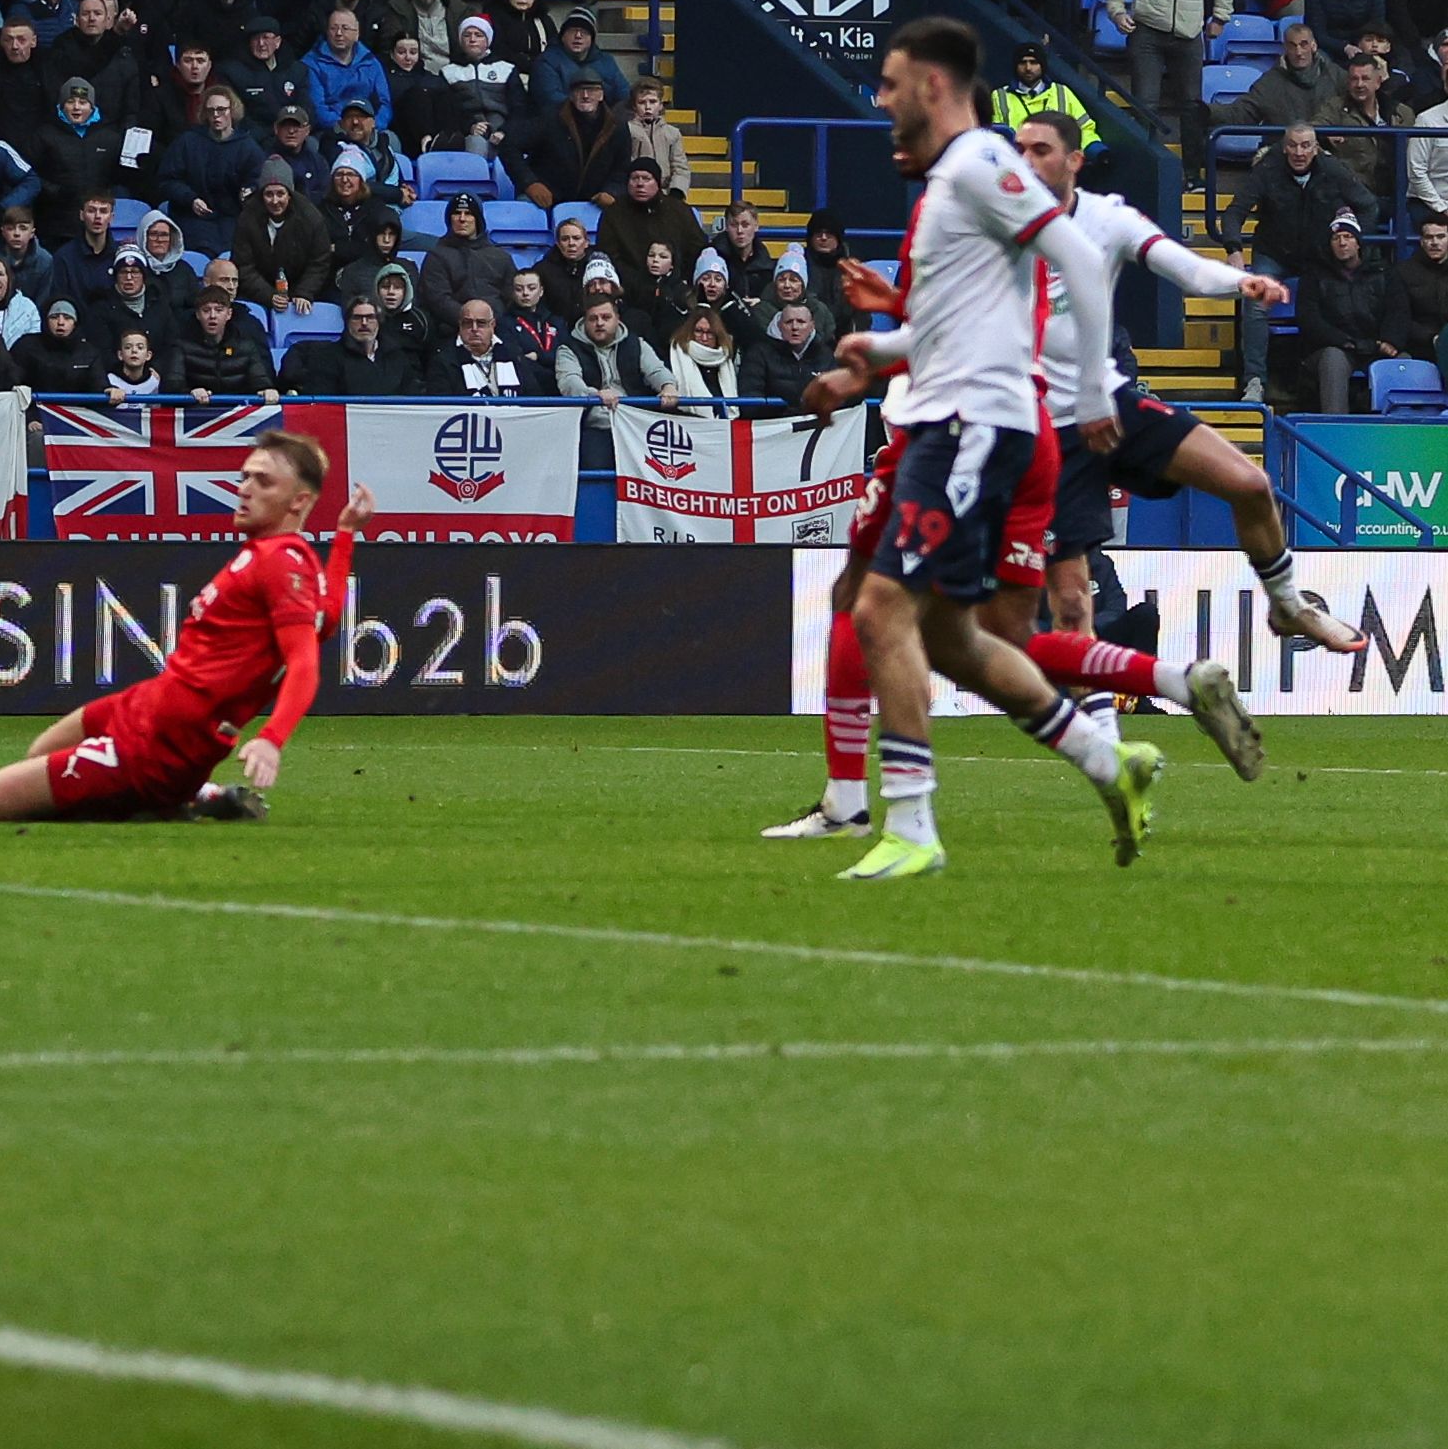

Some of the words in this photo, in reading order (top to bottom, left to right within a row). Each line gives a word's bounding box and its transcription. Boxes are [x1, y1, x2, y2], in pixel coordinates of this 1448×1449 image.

[839, 25, 874, 48] Kia
[792, 419, 827, 482] 7
[627, 479, 761, 516] BREIGHTMET
[767, 492, 797, 513] ON
[803, 479, 854, 508] TOUR
[340, 573, 544, 688] b2b
